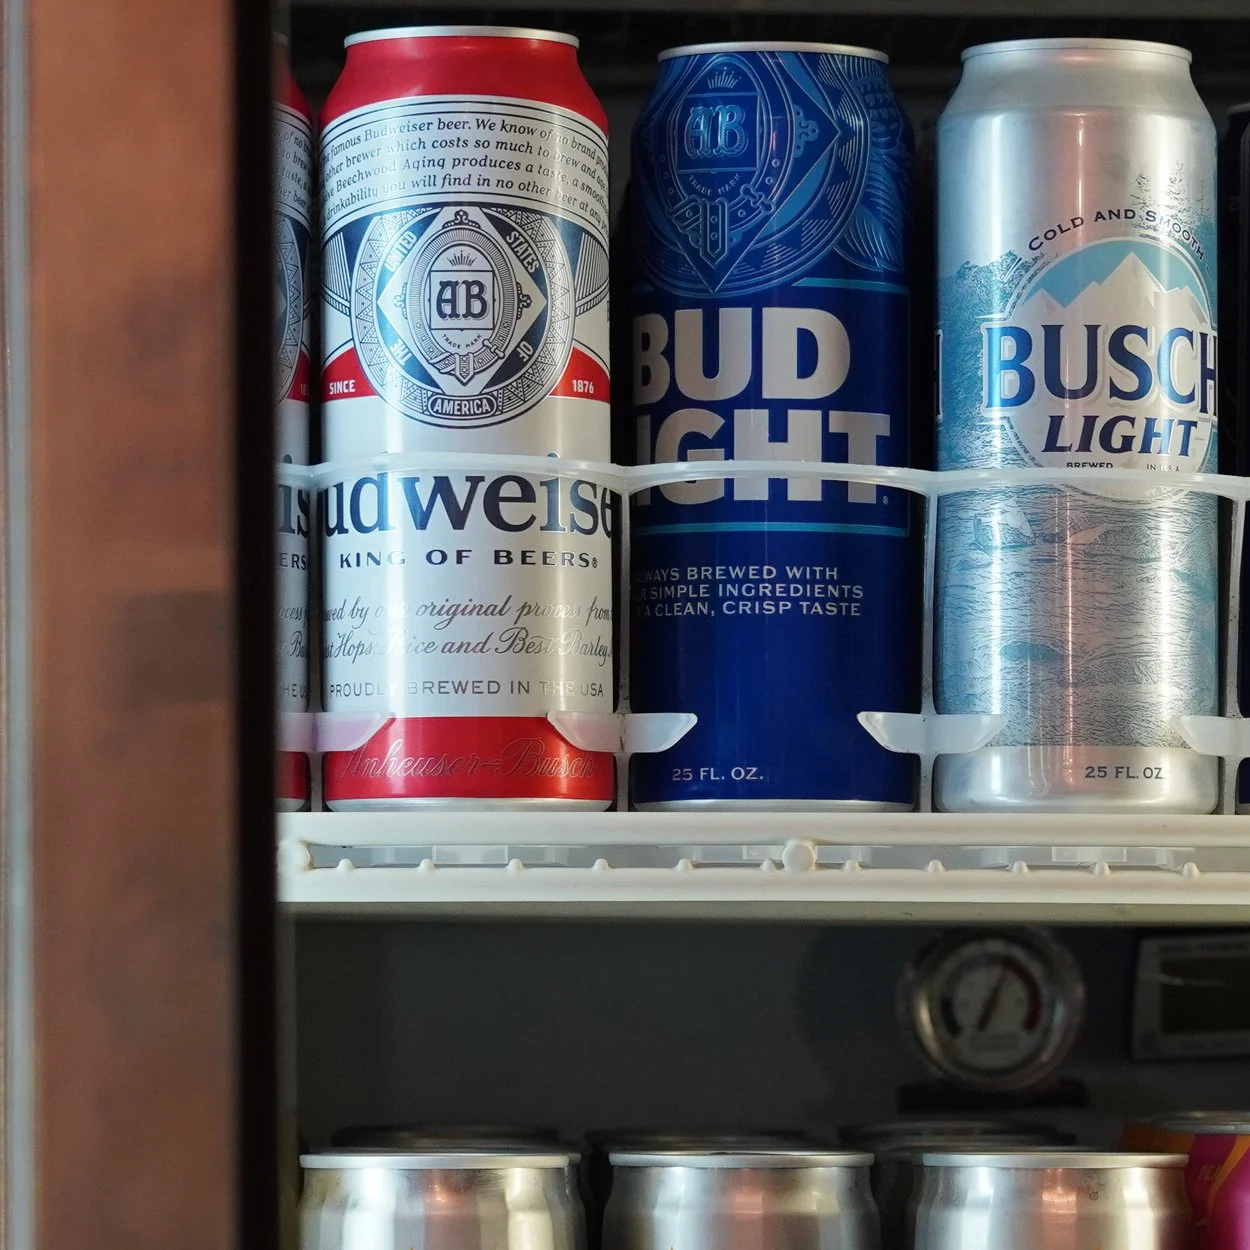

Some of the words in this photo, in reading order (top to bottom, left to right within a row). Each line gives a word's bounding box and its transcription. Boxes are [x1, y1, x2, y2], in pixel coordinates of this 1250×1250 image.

[364, 120, 433, 141] Budweiser
[437, 118, 471, 131] beer.
[476, 118, 496, 131] We
[500, 120, 538, 136] know
[540, 129, 554, 141] of
[345, 146, 382, 168] brewer
[386, 137, 427, 154] which
[431, 137, 469, 149] costs
[474, 139, 490, 149] so
[495, 140, 533, 154] much
[537, 146, 550, 158] to
[402, 157, 446, 171] Aging
[452, 155, 521, 170] produces
[410, 174, 437, 189] will
[440, 173, 472, 189] find
[477, 174, 490, 187] in
[495, 179, 514, 189] no
[518, 181, 551, 196] other
[1028, 216, 1085, 252] COLD
[1094, 208, 1136, 223] AND
[1145, 210, 1206, 261] SMOOTH
[384, 230, 419, 273] UNITED
[506, 231, 541, 274] STATES
[441, 333, 464, 350] TRADE
[465, 333, 483, 350] MARK
[520, 341, 534, 363] OF
[633, 307, 851, 406] BUD
[329, 379, 356, 395] SINCE
[572, 379, 594, 394] 1876
[432, 398, 492, 415] AMERICA
[1041, 415, 1198, 457] LIGHT
[340, 549, 407, 569] KING
[425, 549, 473, 565] OF
[687, 566, 777, 580] BREWED
[785, 566, 839, 580] WITH
[650, 584, 710, 600] SIMPLE
[718, 583, 864, 599] INGREDIENTS
[416, 594, 511, 631] original
[655, 602, 715, 618] CLEAN,
[722, 601, 792, 615] CRISP
[800, 601, 861, 616] TASTE
[441, 632, 495, 655] and
[495, 625, 555, 656] Best
[407, 680, 501, 696] BREWED
[510, 680, 531, 694] IN
[539, 680, 576, 696] THE
[580, 682, 604, 697] USA
[672, 768, 693, 782] 25
[700, 767, 725, 780] FL.
[731, 767, 764, 780] OZ.
[1085, 766, 1107, 779] 25
[1115, 767, 1139, 779] FL.
